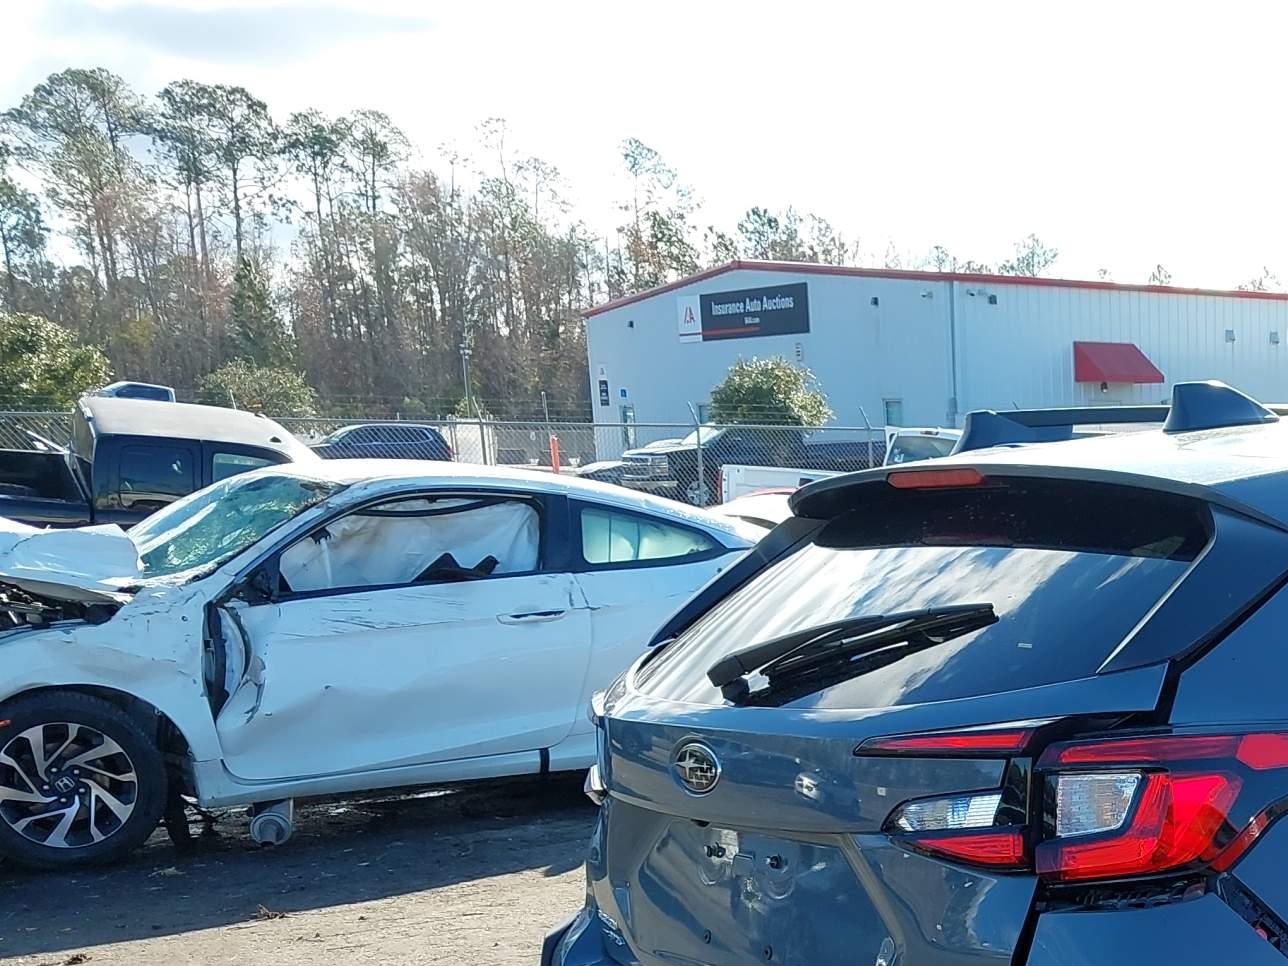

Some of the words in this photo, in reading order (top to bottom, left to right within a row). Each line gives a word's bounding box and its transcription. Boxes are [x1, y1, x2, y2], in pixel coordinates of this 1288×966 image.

[711, 301, 744, 316] Insurance
[745, 297, 762, 312] Auto
[762, 293, 794, 310] Auctions
